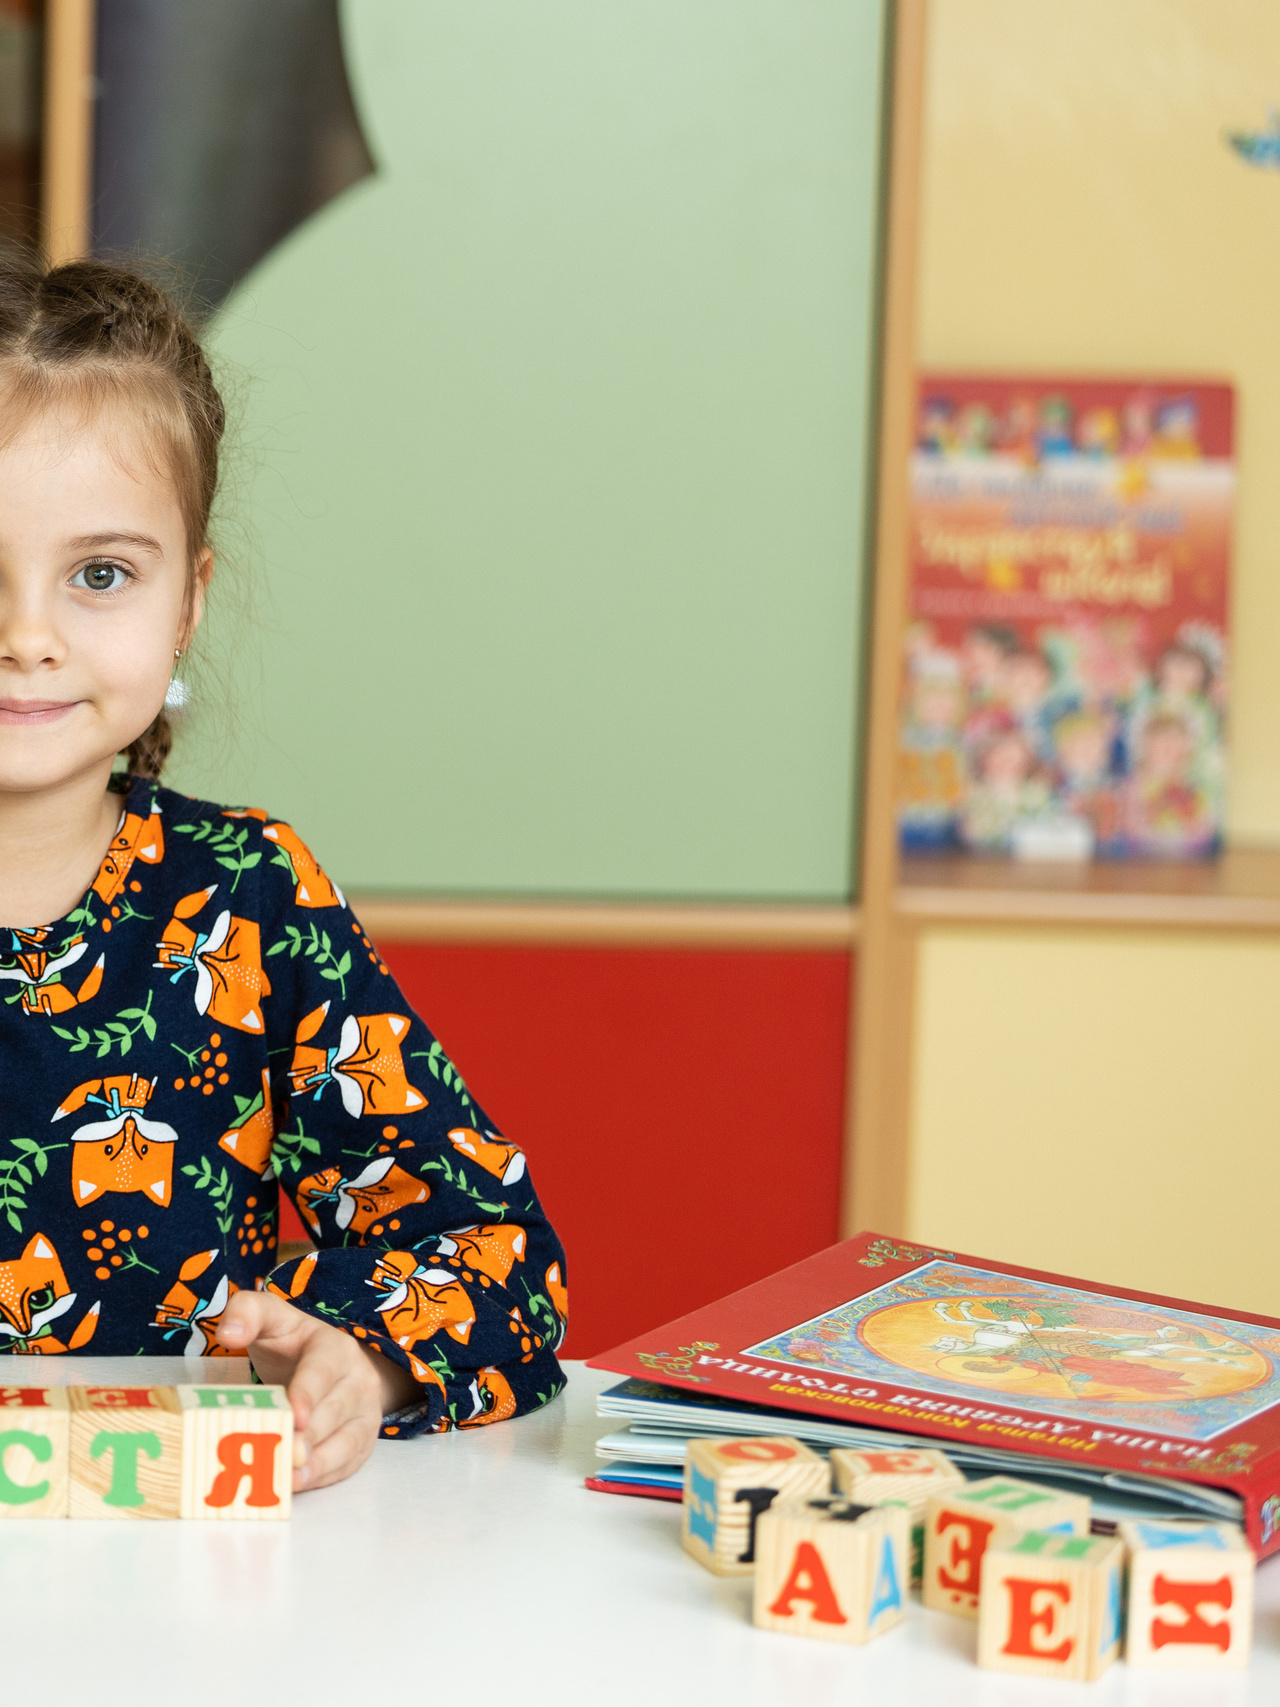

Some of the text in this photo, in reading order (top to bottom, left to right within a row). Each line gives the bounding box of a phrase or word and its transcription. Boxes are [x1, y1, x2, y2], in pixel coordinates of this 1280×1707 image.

[694, 1354, 1215, 1460] НАША ДРЕВНЯЯ СТОЛИЦА
[768, 1383, 1099, 1453] Наталья Кончаловская
[717, 1442, 798, 1462] О
[767, 1540, 849, 1626] А
[1000, 1576, 1075, 1664] Е
